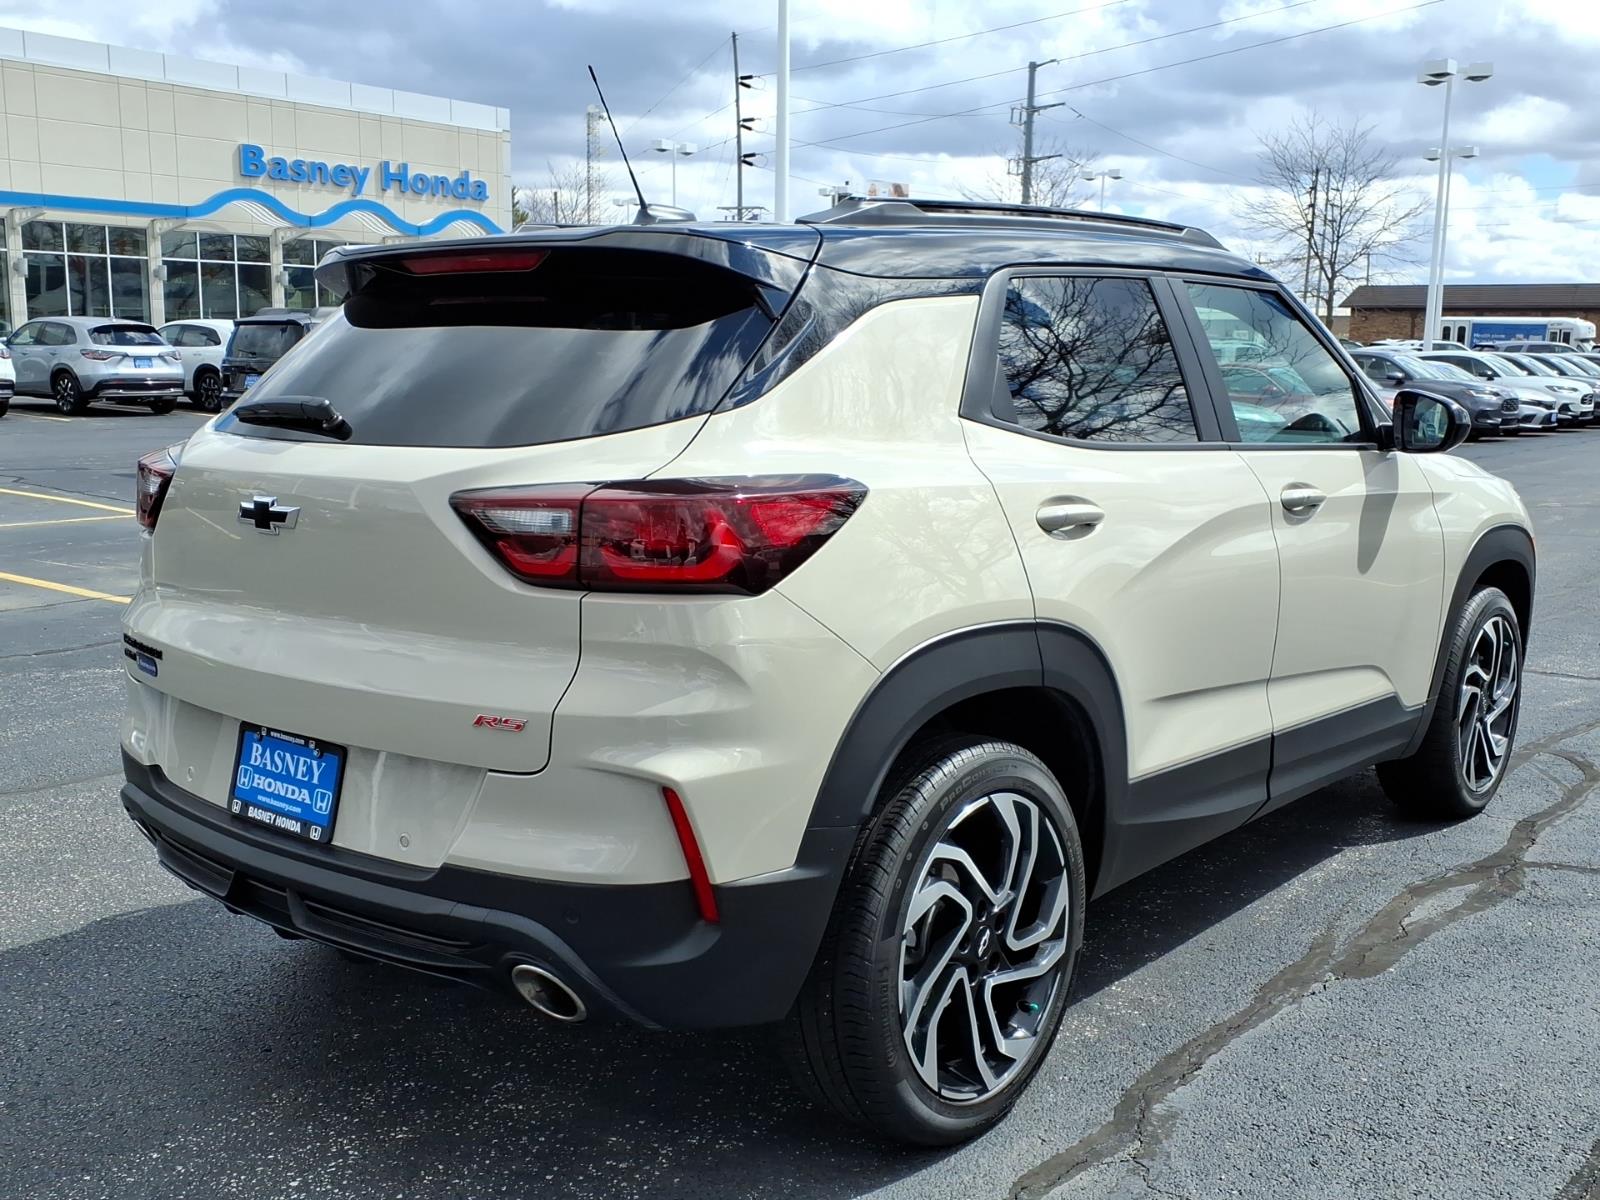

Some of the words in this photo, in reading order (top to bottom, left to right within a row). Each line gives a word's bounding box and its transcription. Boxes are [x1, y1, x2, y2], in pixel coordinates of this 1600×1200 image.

[239, 143, 371, 197] Basney
[379, 160, 489, 201] Honda
[473, 714, 528, 732] RS
[250, 742, 326, 785] BASNEY
[252, 773, 311, 804] HONDA
[248, 806, 276, 824] BASNEY
[276, 816, 301, 833] HONDA
